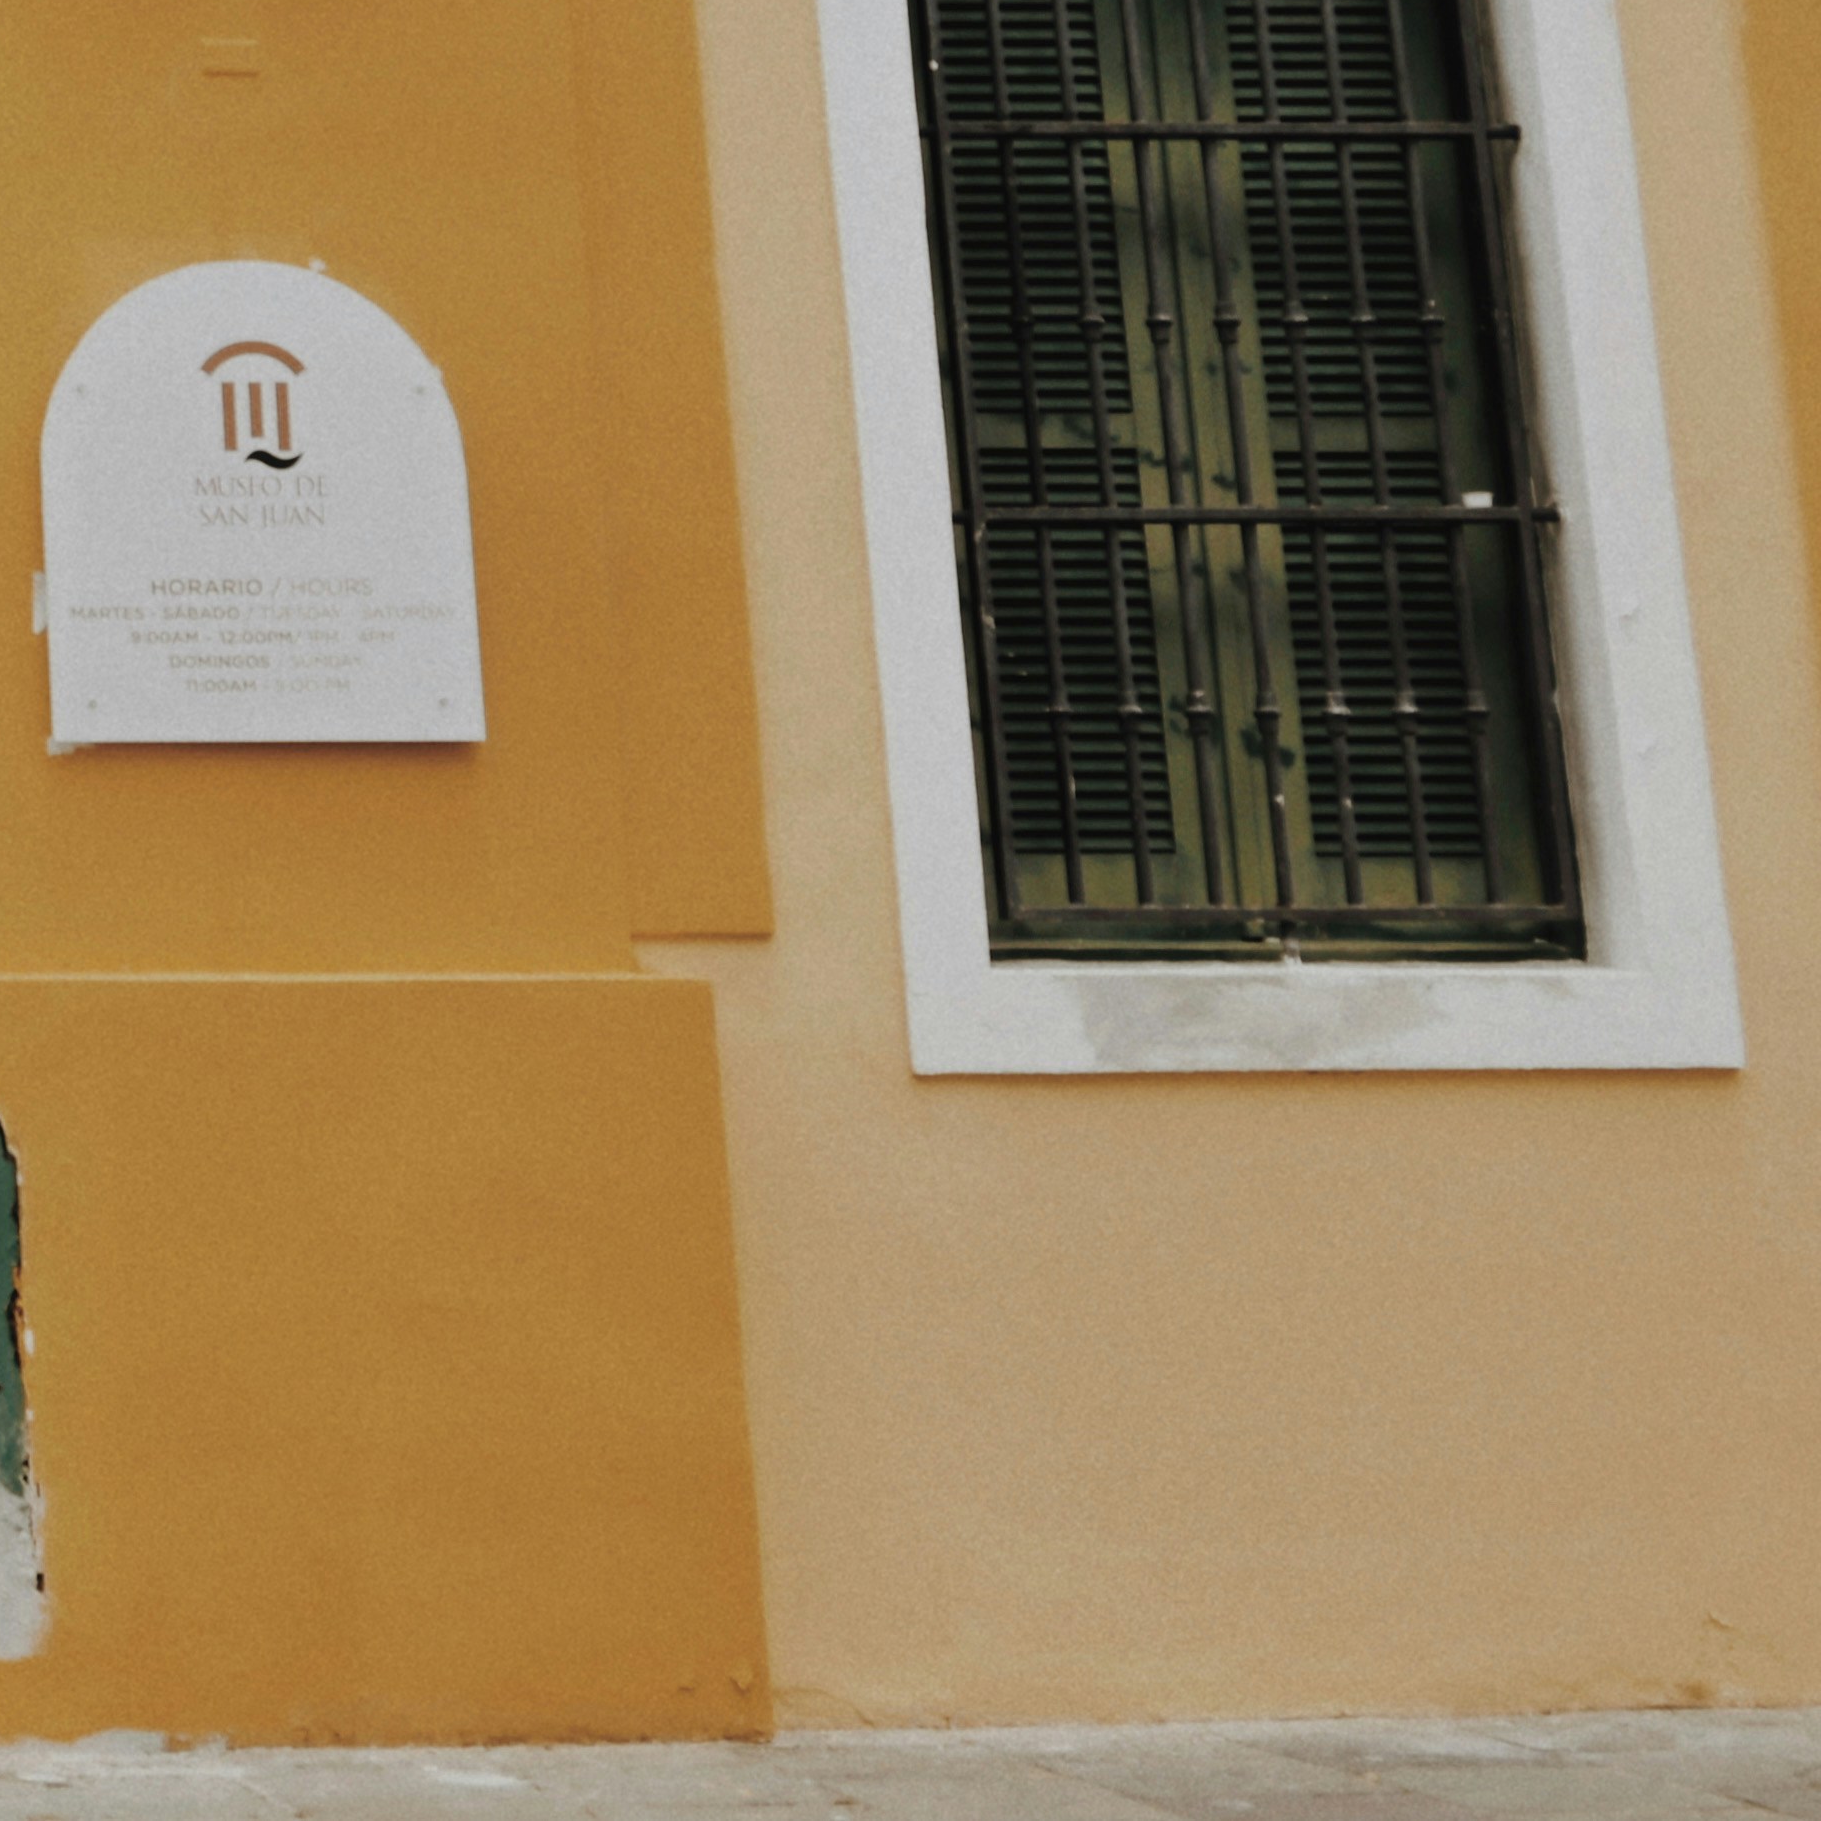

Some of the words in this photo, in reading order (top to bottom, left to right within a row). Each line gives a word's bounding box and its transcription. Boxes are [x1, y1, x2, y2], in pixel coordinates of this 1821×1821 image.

[195, 475, 282, 497] MUSEO
[296, 475, 329, 497] DE
[199, 505, 248, 526] SAN
[262, 504, 325, 528] JUAN
[151, 579, 263, 596] HORARIO
[291, 578, 373, 597] HOURS
[70, 606, 145, 620] MARTES
[169, 655, 271, 669] DOMINGOS
